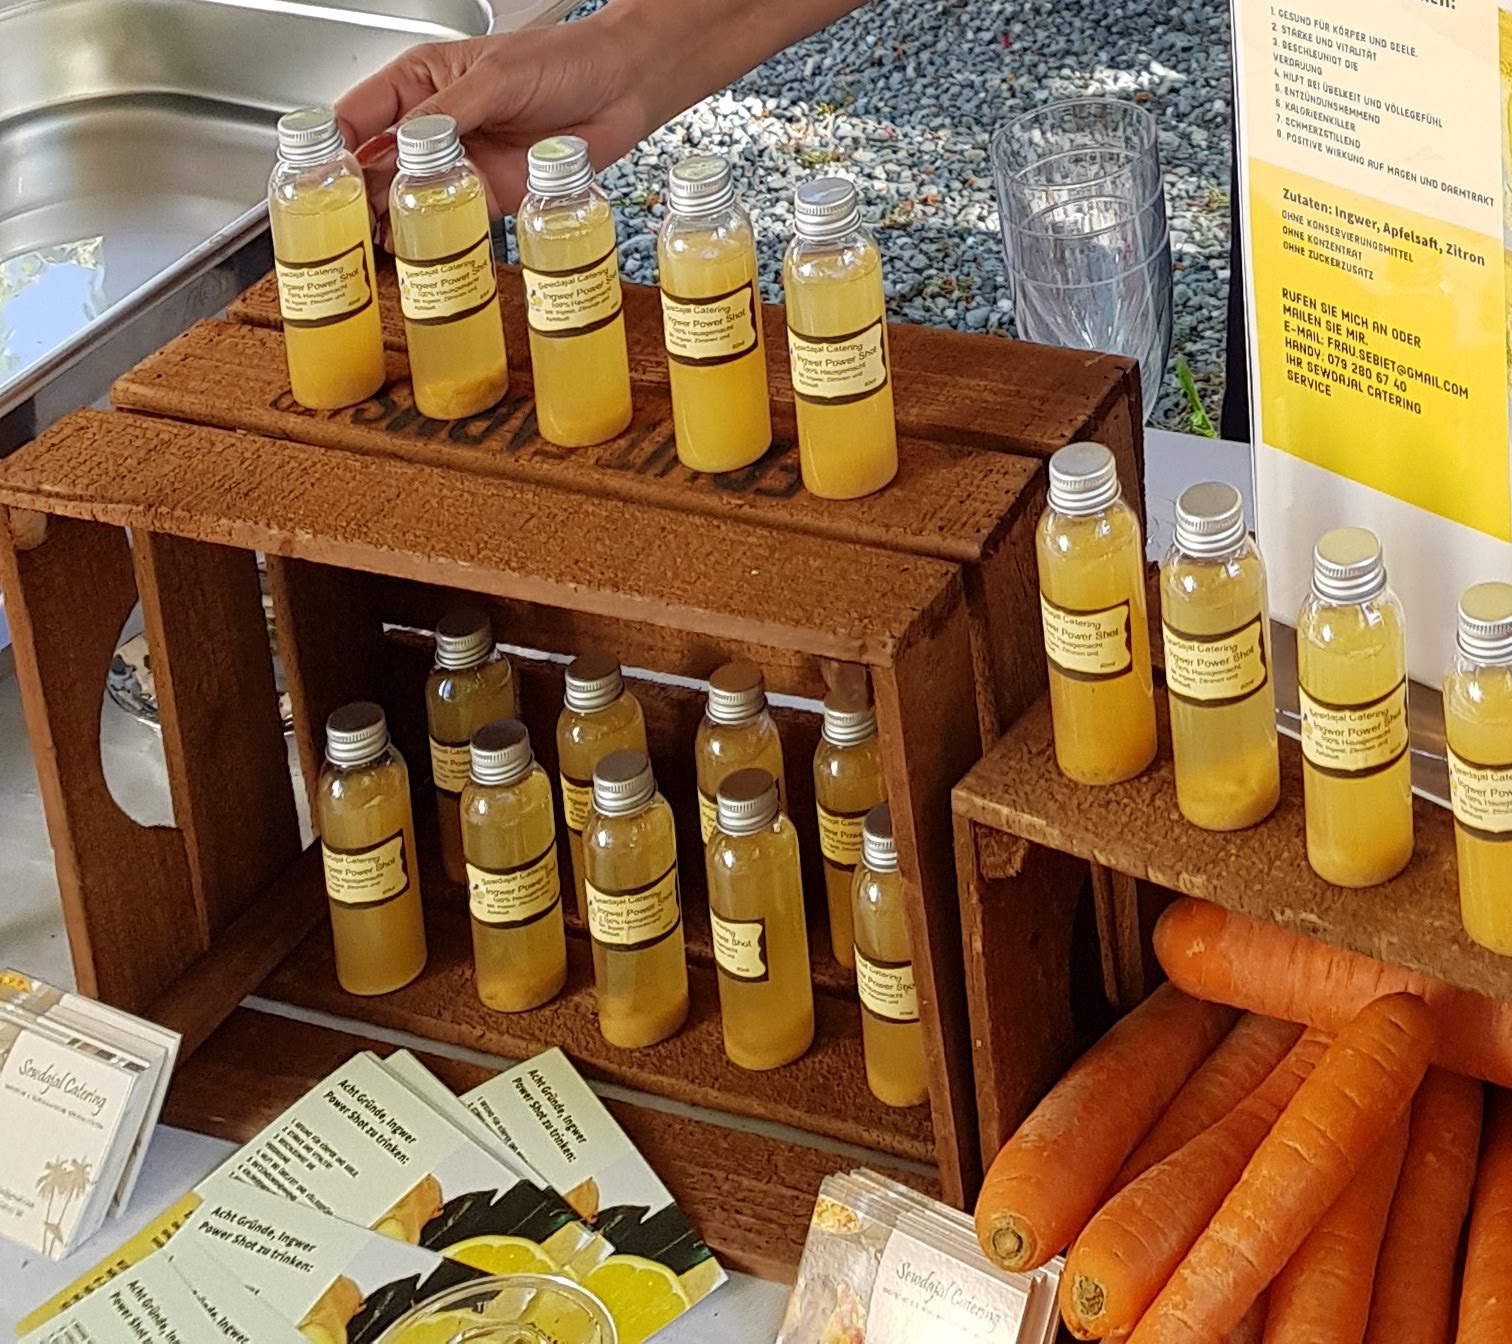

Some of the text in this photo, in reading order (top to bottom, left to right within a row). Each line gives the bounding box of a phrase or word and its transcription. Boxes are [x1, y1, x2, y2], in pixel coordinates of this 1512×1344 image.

[1278, 9, 1311, 26] GESUND
[1314, 19, 1330, 32] FÜR
[1333, 25, 1366, 42] KÖRPER
[1369, 36, 1387, 48] UND
[1316, 35, 1333, 48] UND
[1273, 53, 1322, 75] VERDAUUNG
[1282, 41, 1358, 71] BESCHLEUNIGT DIE
[1283, 71, 1442, 128] HILFT BEI ÜBELKEIT UND VÖLLEGEFÜHL
[1287, 133, 1494, 207] POSITIVE WIRKUNG AUF MAGEN UND DARMTRAKT
[1282, 210, 1413, 262] OHNE KONSERVIERUNGSMITTEL
[1283, 188, 1485, 266] Zutaten: Ingwer, Apfelsaft, Zitron
[1283, 226, 1362, 260] OHNE KONZENTRAT
[1283, 241, 1374, 280] OHNE ZUCKERZUSATZ
[693, 309, 745, 327] Power Shot
[1282, 288, 1421, 348] RUFEN SIE MICH AN ODER
[1283, 304, 1368, 345] MAILEN SIE MIR.
[1284, 321, 1469, 399] E-MAIL: FRAU.SEBIET@GMAIL.COM
[1285, 337, 1407, 392] HANDY: 079 280 67 40
[1286, 353, 1421, 414] IHR SEWDAJAL CATERING
[1287, 370, 1331, 397] SERVICE
[63, 1076, 107, 1116] Catering
[337, 1079, 416, 1144] Acht Gründe, Ingwer
[512, 1076, 534, 1103] Power
[529, 1100, 548, 1121] Shot
[549, 1127, 578, 1163] trinken:
[527, 1068, 588, 1145] Acht Gründe, Ingwer
[323, 1090, 409, 1165] Power Shot zu trinken:
[199, 1220, 234, 1243] Power
[234, 1232, 258, 1251] Shot
[256, 1242, 270, 1254] zu
[270, 1246, 314, 1274] trinken:
[210, 1206, 317, 1255] Acht Gründe, Ingwer
